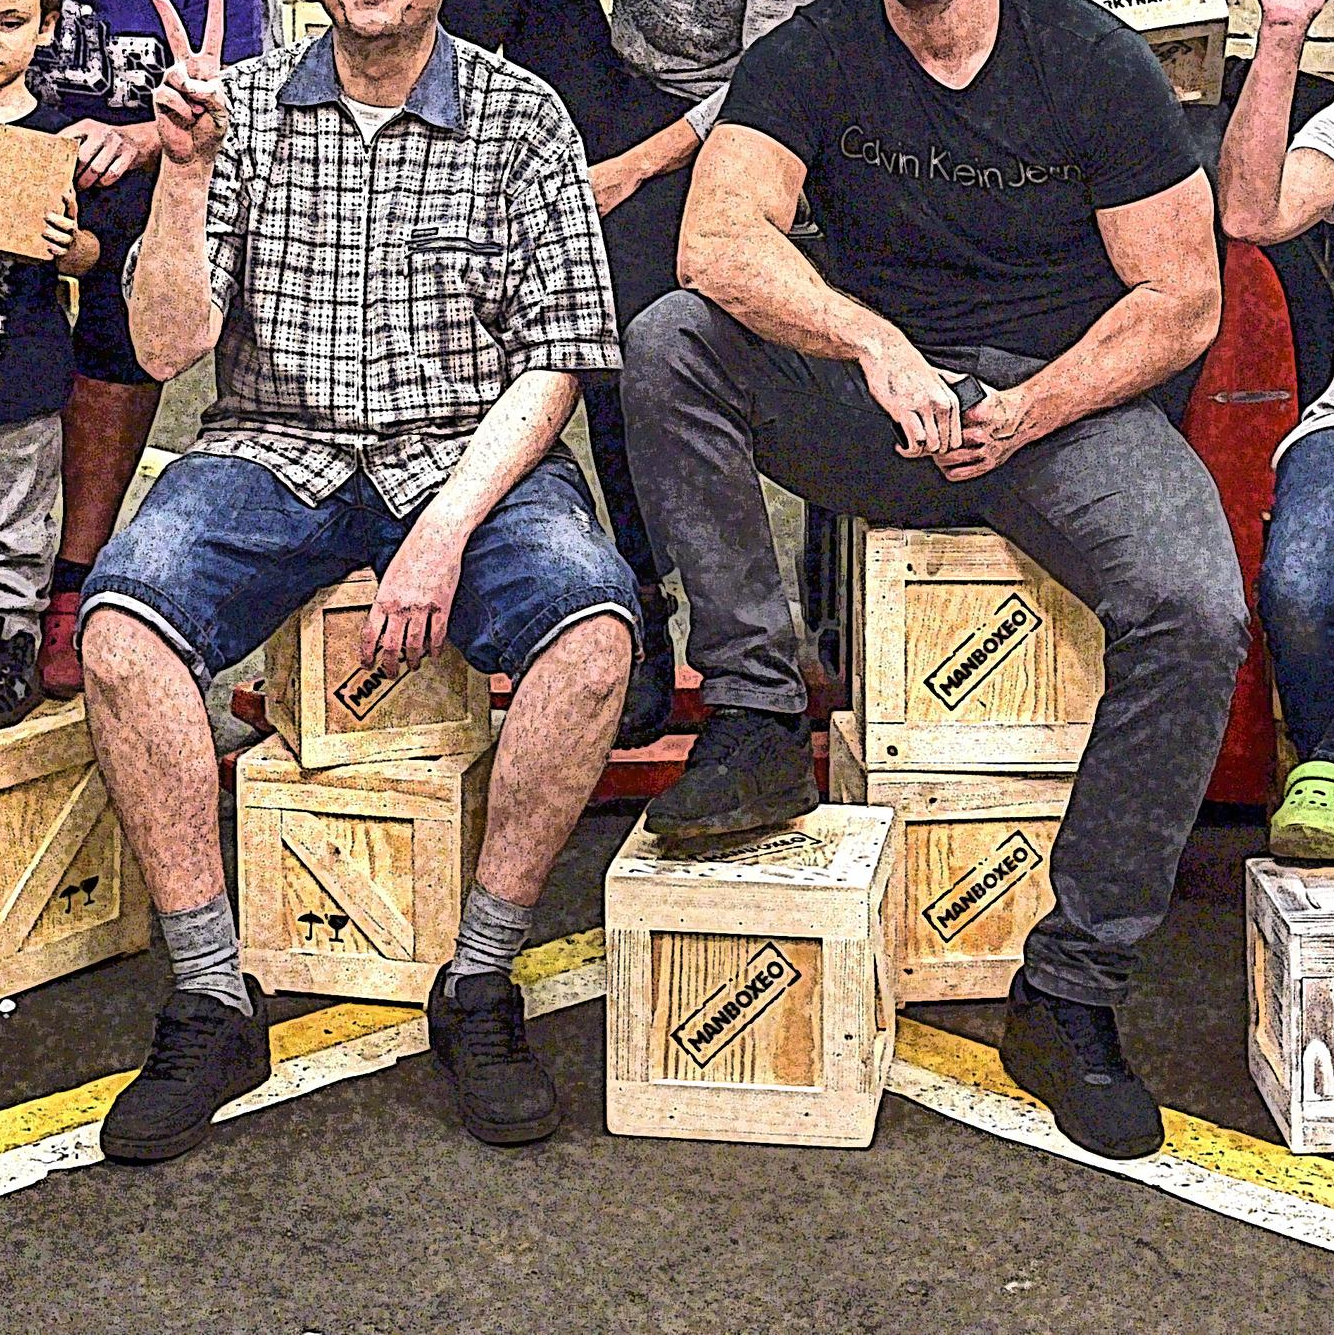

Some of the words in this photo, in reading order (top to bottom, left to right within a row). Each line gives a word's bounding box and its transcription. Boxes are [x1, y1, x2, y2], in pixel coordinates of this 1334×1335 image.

[929, 145, 1004, 190] Kein
[939, 608, 1029, 696] MANBOXEO
[938, 847, 1029, 928] MANBOXEO
[689, 961, 785, 1052] MANBOXEO
